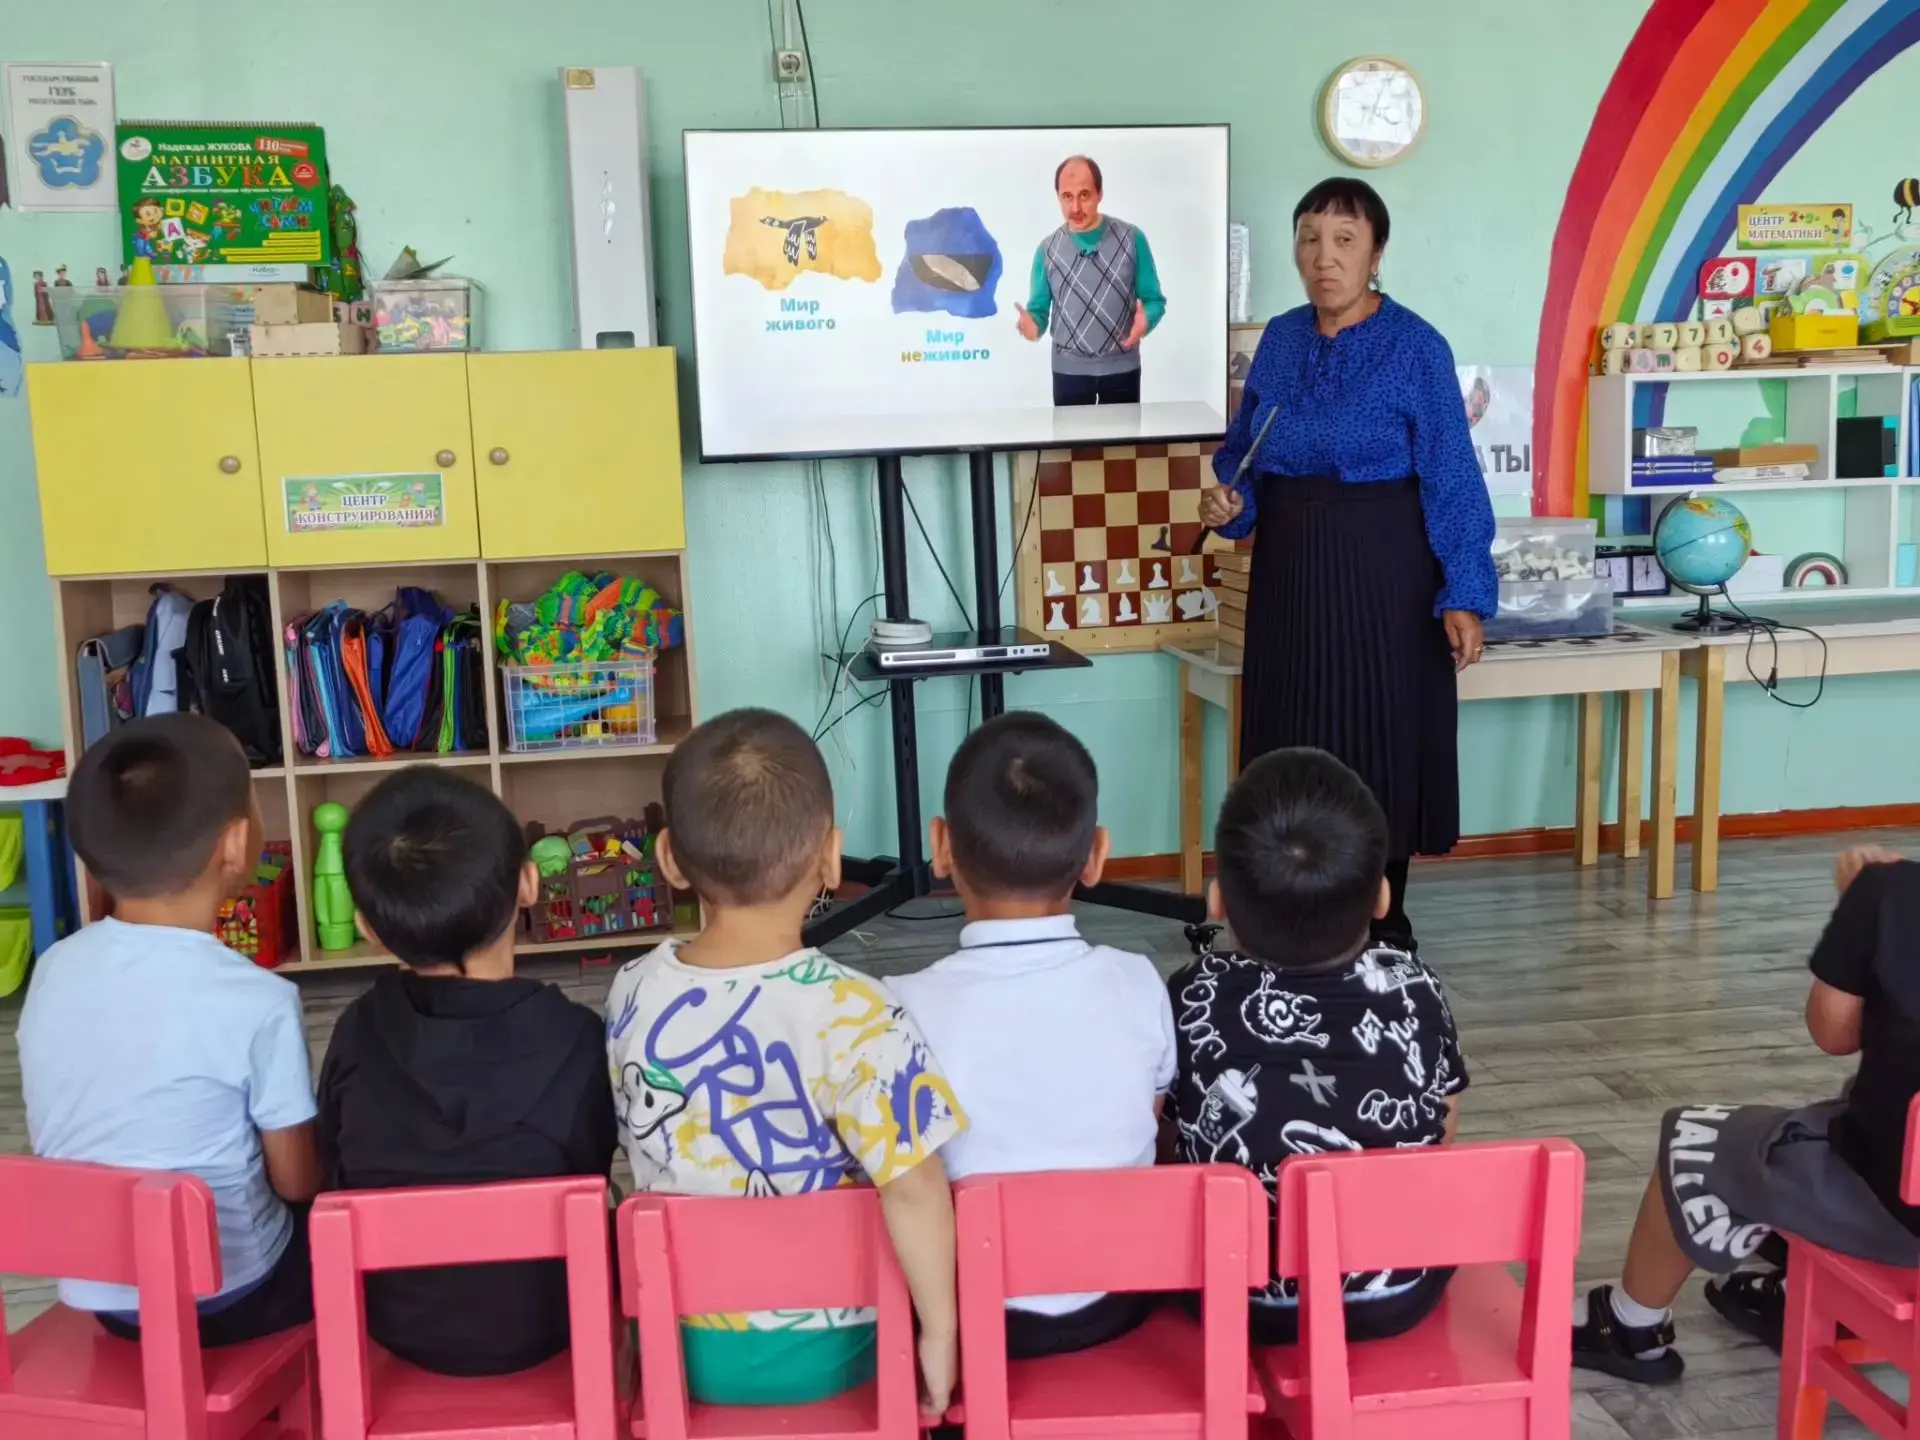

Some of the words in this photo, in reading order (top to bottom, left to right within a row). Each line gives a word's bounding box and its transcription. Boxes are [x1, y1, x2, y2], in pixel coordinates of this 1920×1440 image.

[207, 142, 253, 151] ЖУКОВА
[259, 138, 279, 151] 110
[152, 155, 281, 165] МАГНИТНАЯ
[142, 165, 293, 187] АЗБУКА
[1749, 216, 1785, 226] ЦЕНТР
[1748, 229, 1822, 239] МАТЕМАТИКИ
[780, 298, 820, 314] Мир
[765, 317, 836, 331] живого
[926, 329, 965, 345] Мир
[901, 347, 990, 362] неживого
[343, 494, 388, 507] ЦЕНТР
[298, 509, 434, 525] КОНСТРУИРОВАНИЯ
